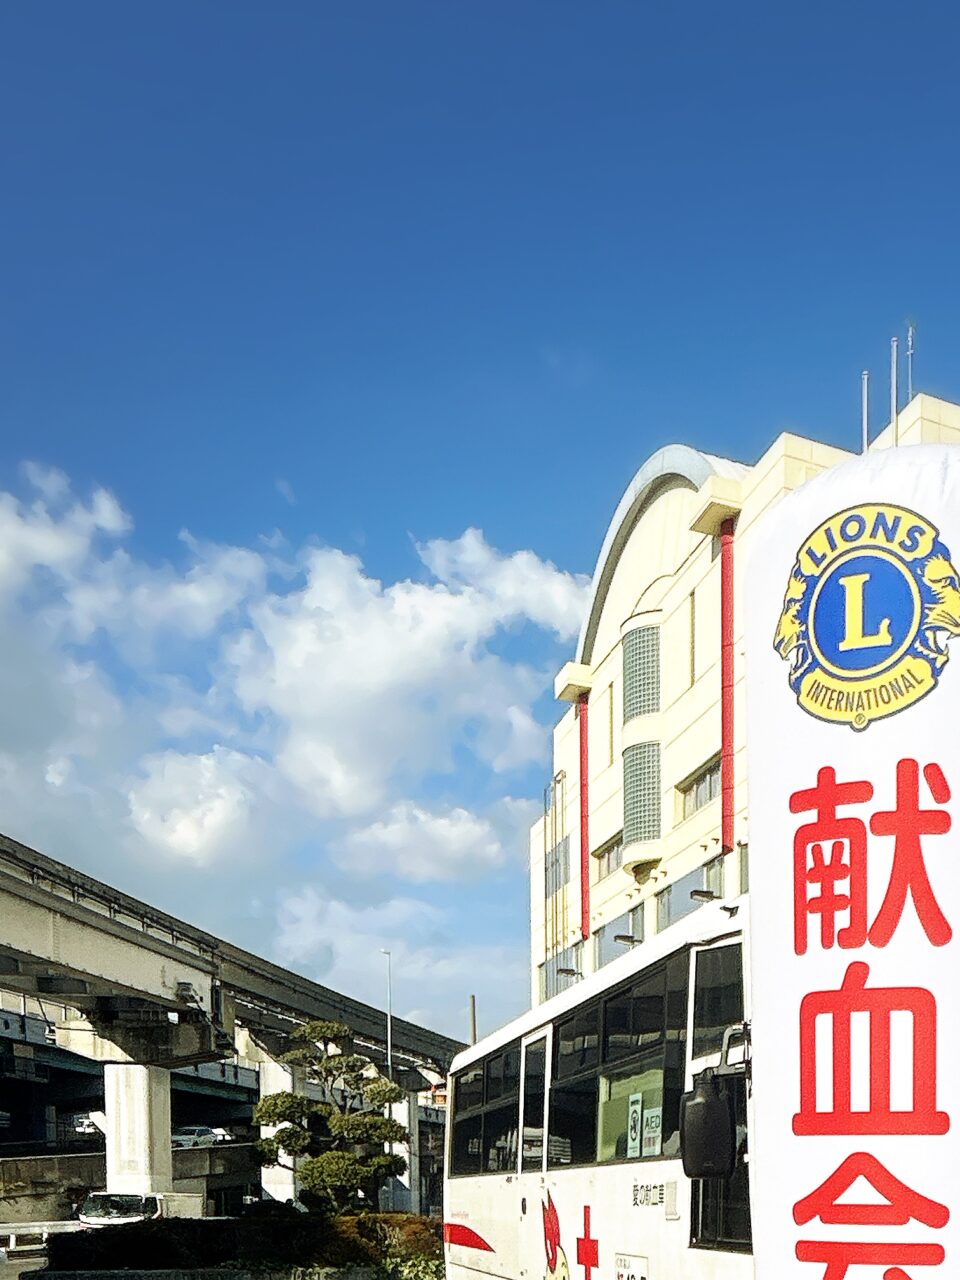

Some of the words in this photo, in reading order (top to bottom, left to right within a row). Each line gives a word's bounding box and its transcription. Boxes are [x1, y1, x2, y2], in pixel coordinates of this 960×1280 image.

[805, 512, 927, 569] LIONS
[839, 573, 894, 652] L
[806, 669, 926, 713] INTERNATIONAL
[645, 1115, 661, 1130] AED
